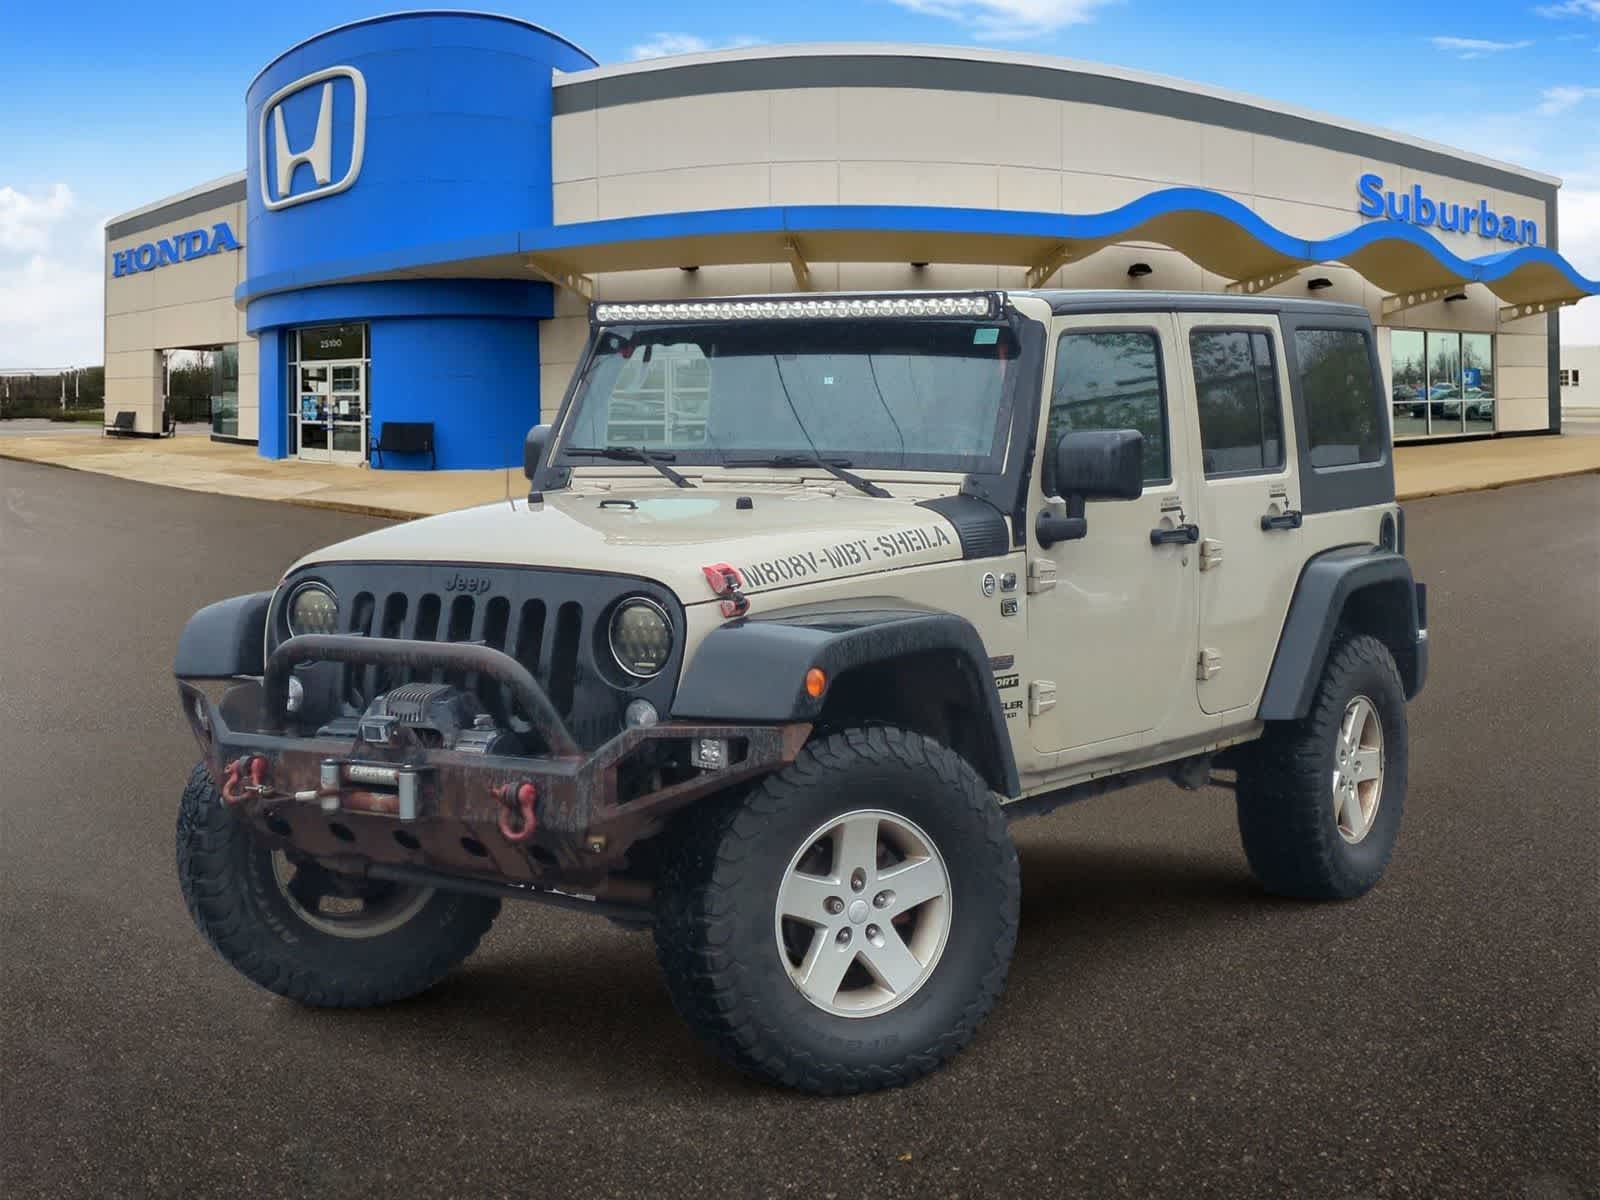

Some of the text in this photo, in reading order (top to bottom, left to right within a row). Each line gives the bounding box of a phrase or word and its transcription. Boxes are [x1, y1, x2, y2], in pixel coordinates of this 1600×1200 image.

[1358, 173, 1537, 245] Suburban
[112, 221, 242, 278] HONDA
[444, 574, 491, 596] Jeep
